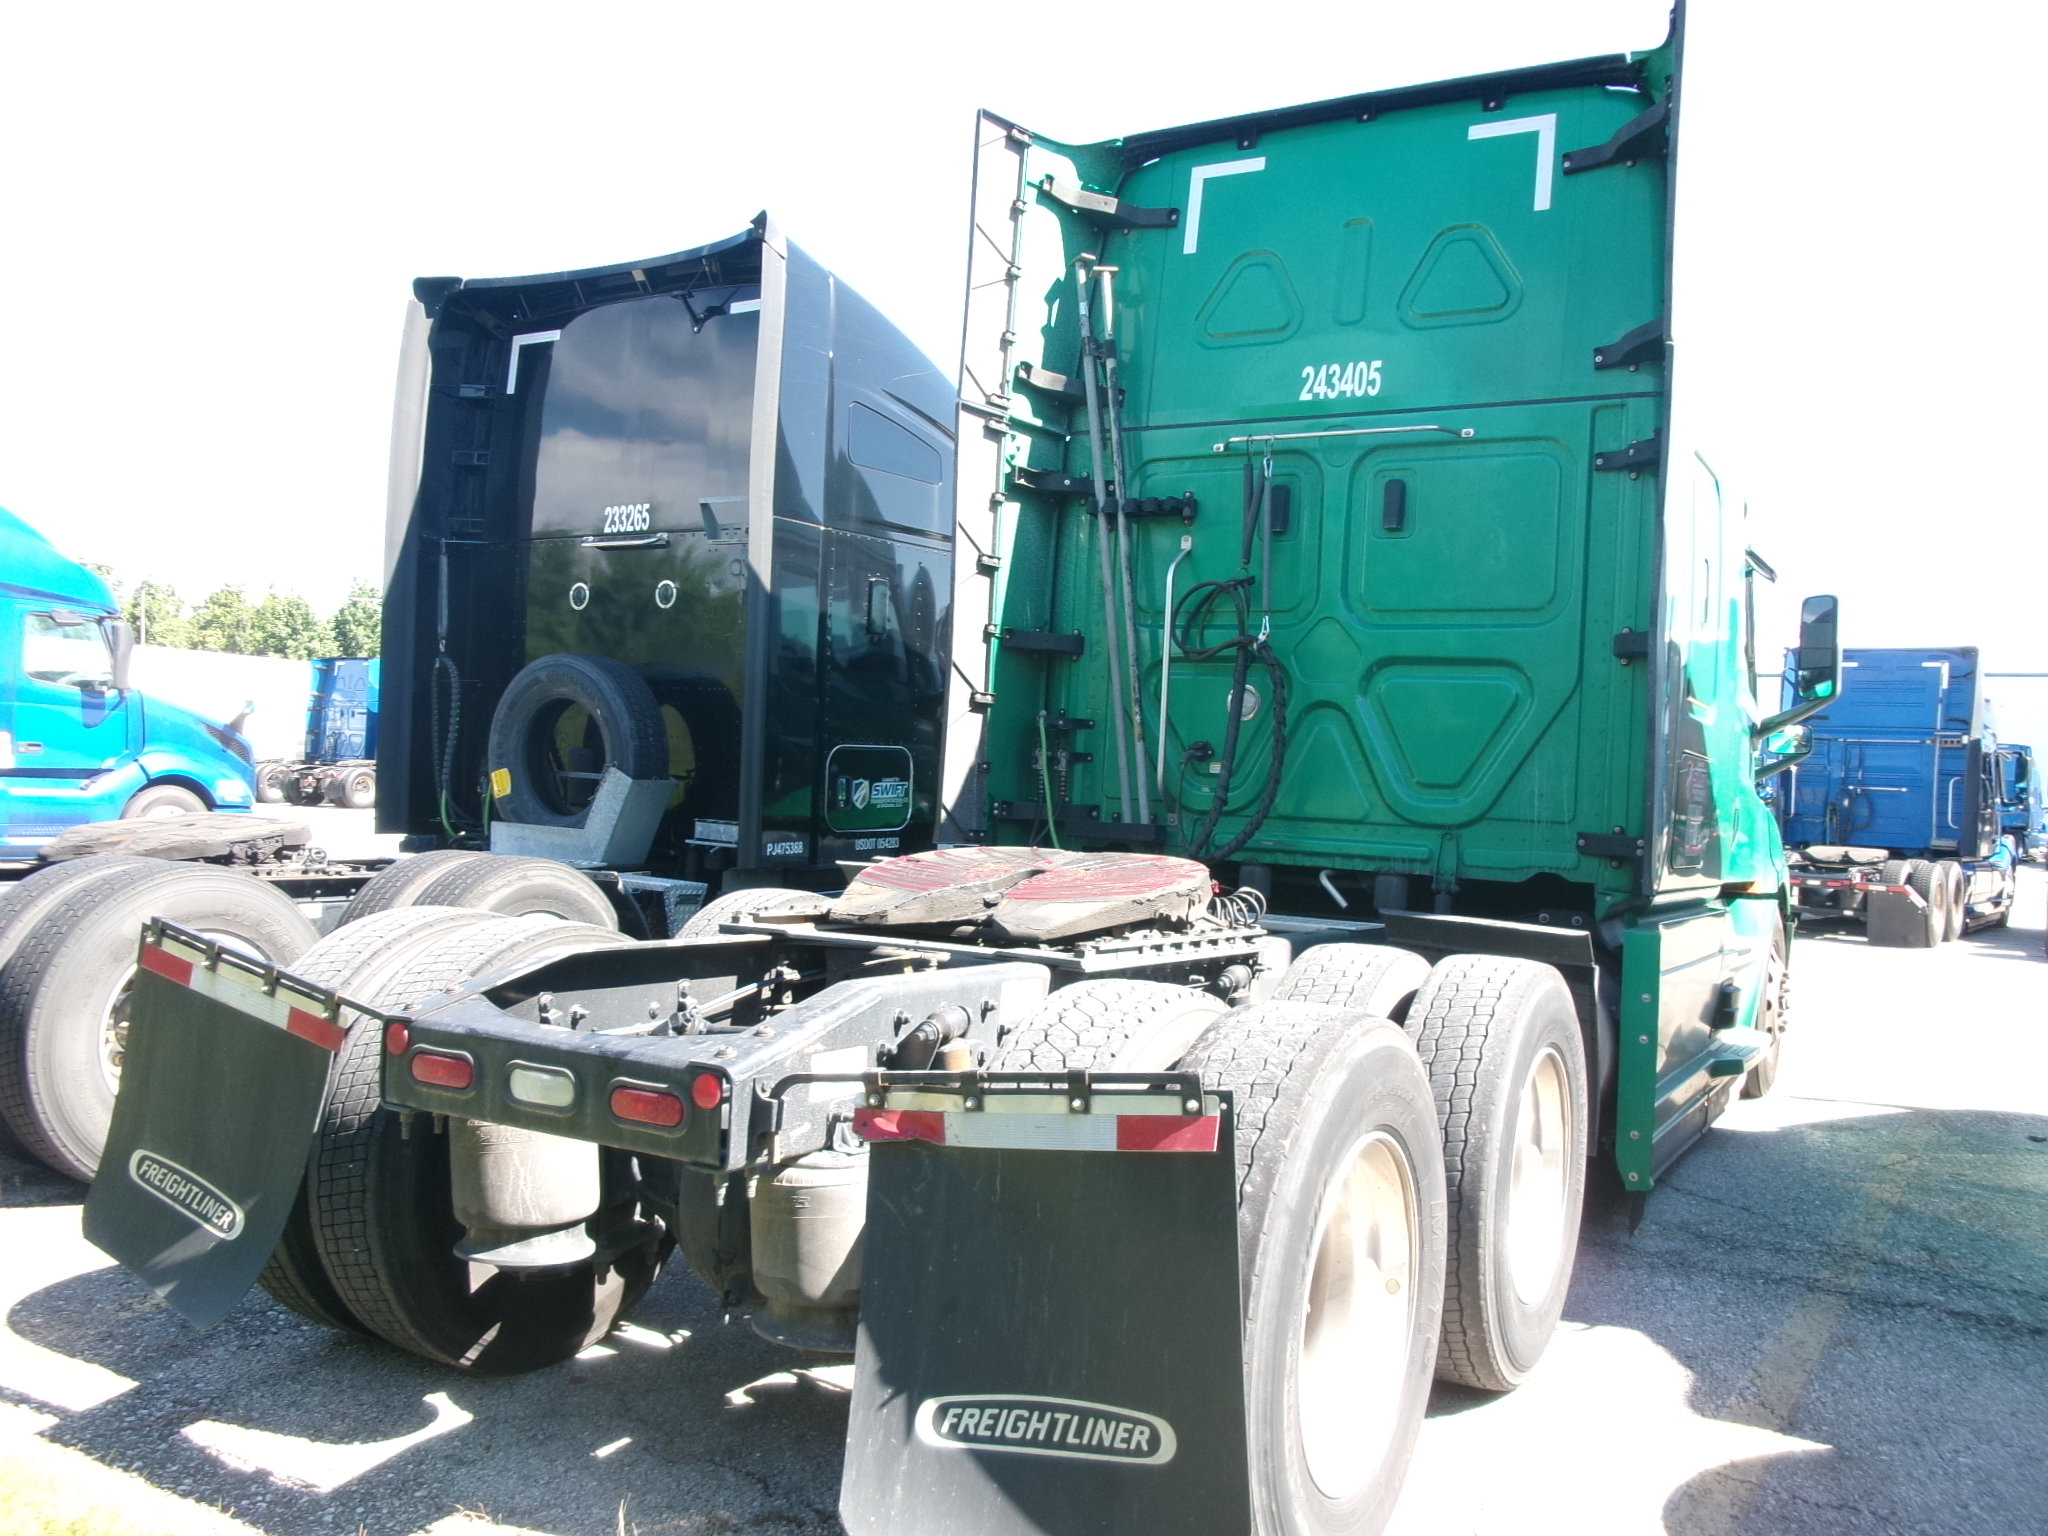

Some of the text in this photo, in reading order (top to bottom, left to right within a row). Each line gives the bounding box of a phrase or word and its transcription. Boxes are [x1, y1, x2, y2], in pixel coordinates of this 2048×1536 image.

[1299, 360, 1382, 401] 243405
[603, 503, 650, 533] 233265
[872, 783, 908, 798] SWIFT
[139, 1160, 234, 1230] FREIGHTLINER
[940, 1407, 1150, 1451] FREIGHTLINER
